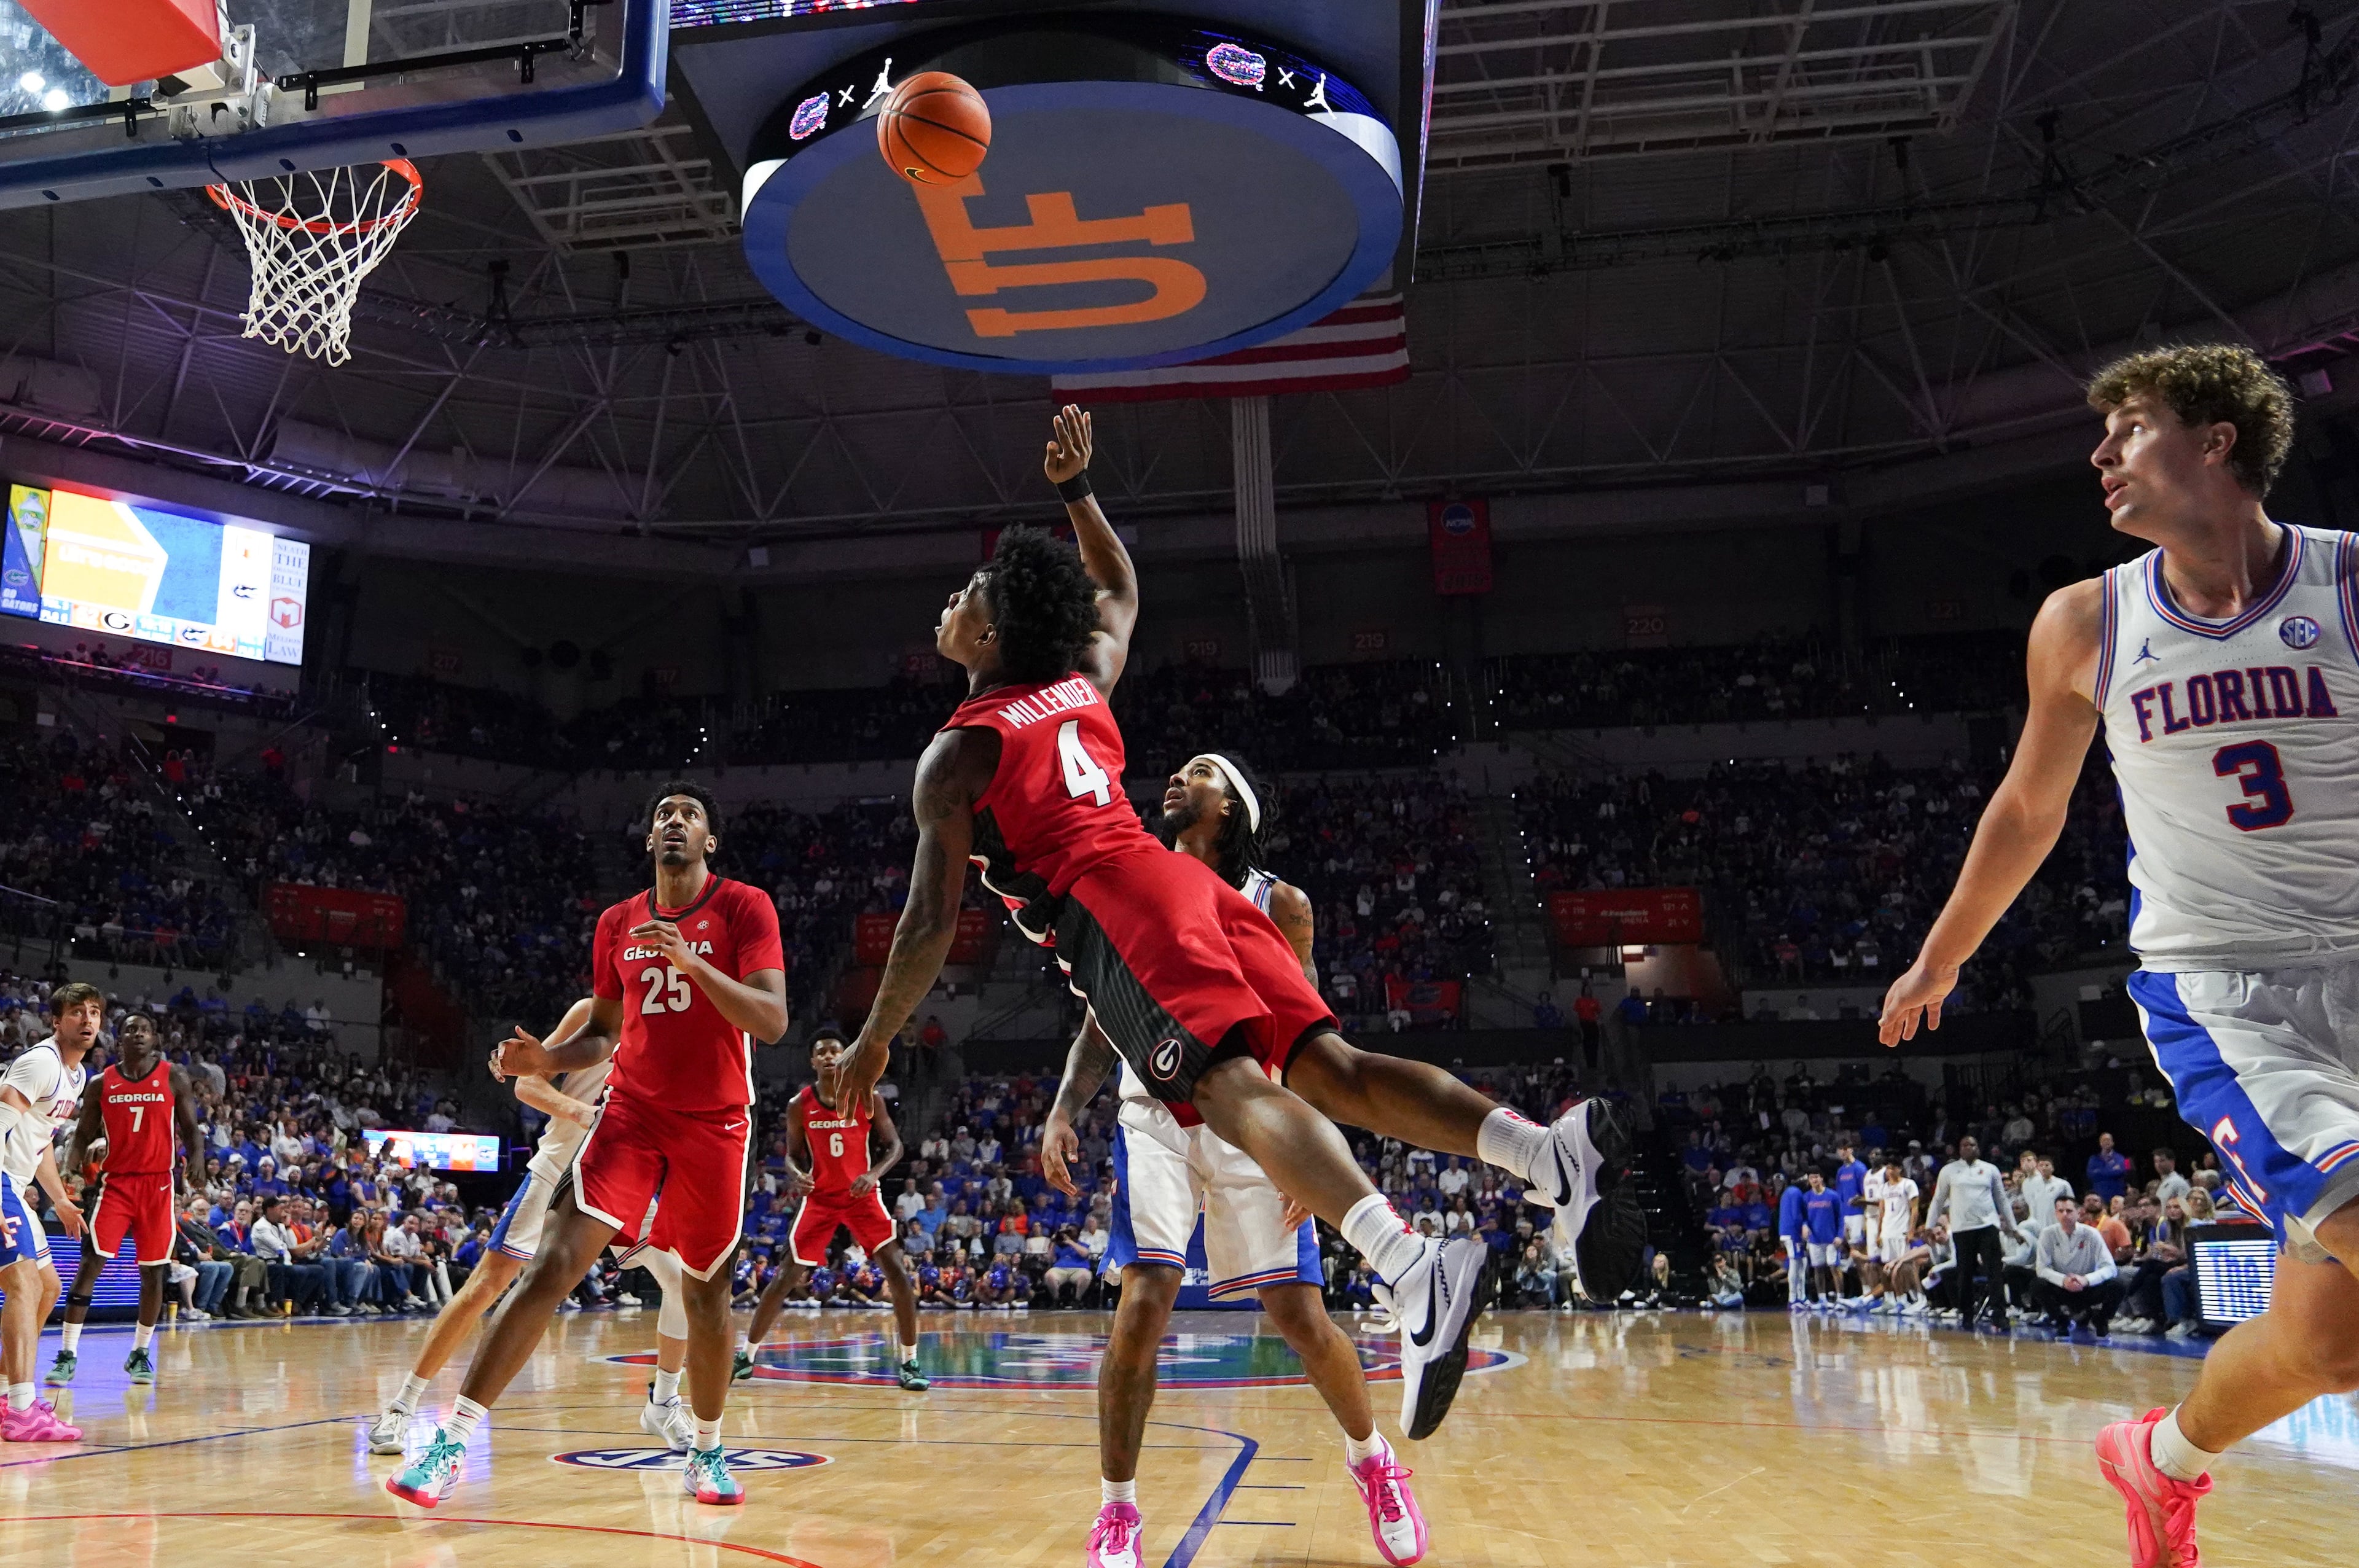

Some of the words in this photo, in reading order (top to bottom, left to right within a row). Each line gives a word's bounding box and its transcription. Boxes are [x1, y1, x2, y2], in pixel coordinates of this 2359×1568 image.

[911, 170, 1208, 337] UF
[276, 553, 306, 569] THE
[273, 574, 305, 587] BLUE
[1, 598, 39, 613] GATORS
[1627, 618, 1665, 634] 220
[2283, 617, 2318, 647] SEC
[267, 641, 299, 658] LAW
[1189, 641, 1217, 656] 219
[1355, 634, 1384, 649] 219
[139, 651, 168, 667] 216
[997, 676, 1098, 730] MILLENDER
[2130, 666, 2338, 743] FLORIDA
[1057, 719, 1111, 808] 4
[2212, 739, 2295, 832] 3
[640, 965, 692, 1015] 25
[108, 1093, 165, 1104] GEORGIA
[129, 1106, 145, 1133] 7
[808, 1119, 859, 1129] GEORGA
[829, 1133, 844, 1158] 6
[2, 1215, 22, 1250] F
